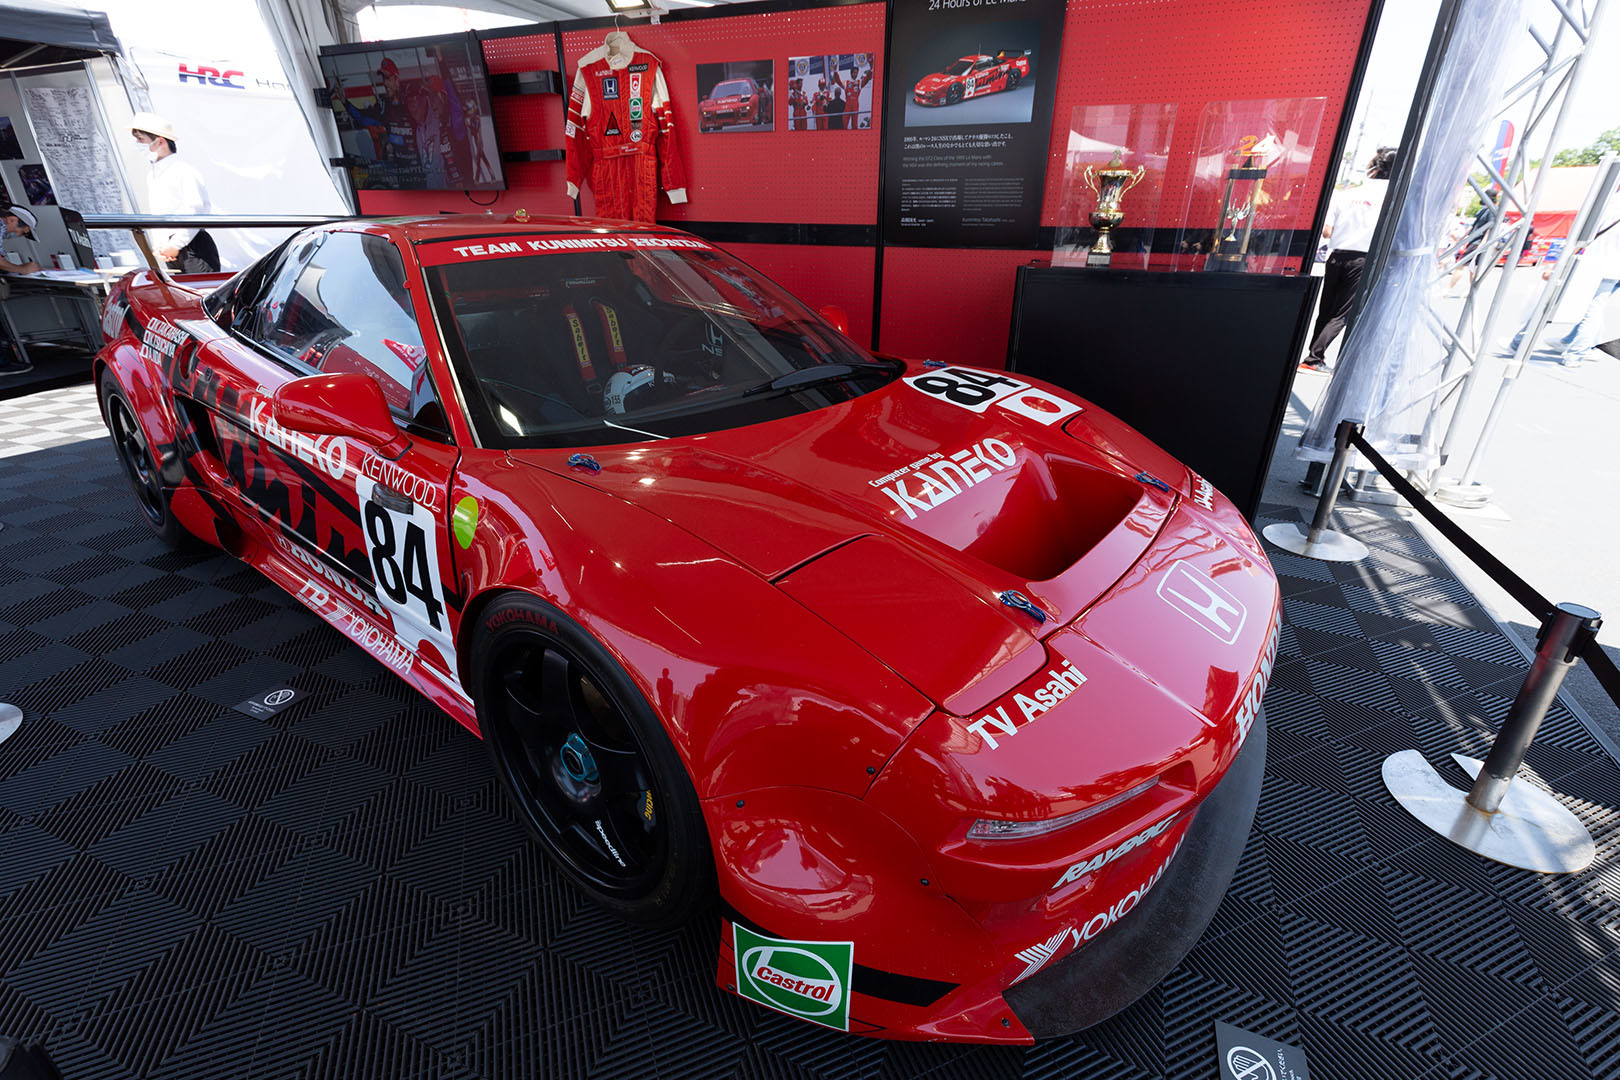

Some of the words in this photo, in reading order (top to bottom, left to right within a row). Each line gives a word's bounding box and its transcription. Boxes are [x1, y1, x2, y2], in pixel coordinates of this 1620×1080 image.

[928, 0, 940, 11] 24
[178, 62, 246, 89] HRC
[453, 242, 523, 257] TEAM
[526, 238, 628, 253] KUNIMITSU
[629, 237, 712, 250] HONDA
[572, 319, 587, 361] Sabelt
[913, 368, 1022, 407] 84
[361, 452, 437, 508] KENWOOD
[868, 466, 911, 488] Computer
[909, 457, 933, 470] game
[928, 451, 945, 460] by
[880, 438, 1017, 521] KANEKO
[290, 546, 389, 620] HONDA
[364, 499, 444, 633] 84
[485, 607, 560, 636] YOKOHAMA
[346, 610, 415, 675] YOKOHAMA
[966, 706, 1019, 751] TV
[1012, 658, 1088, 724] Asahi
[756, 966, 835, 1002] Castrol
